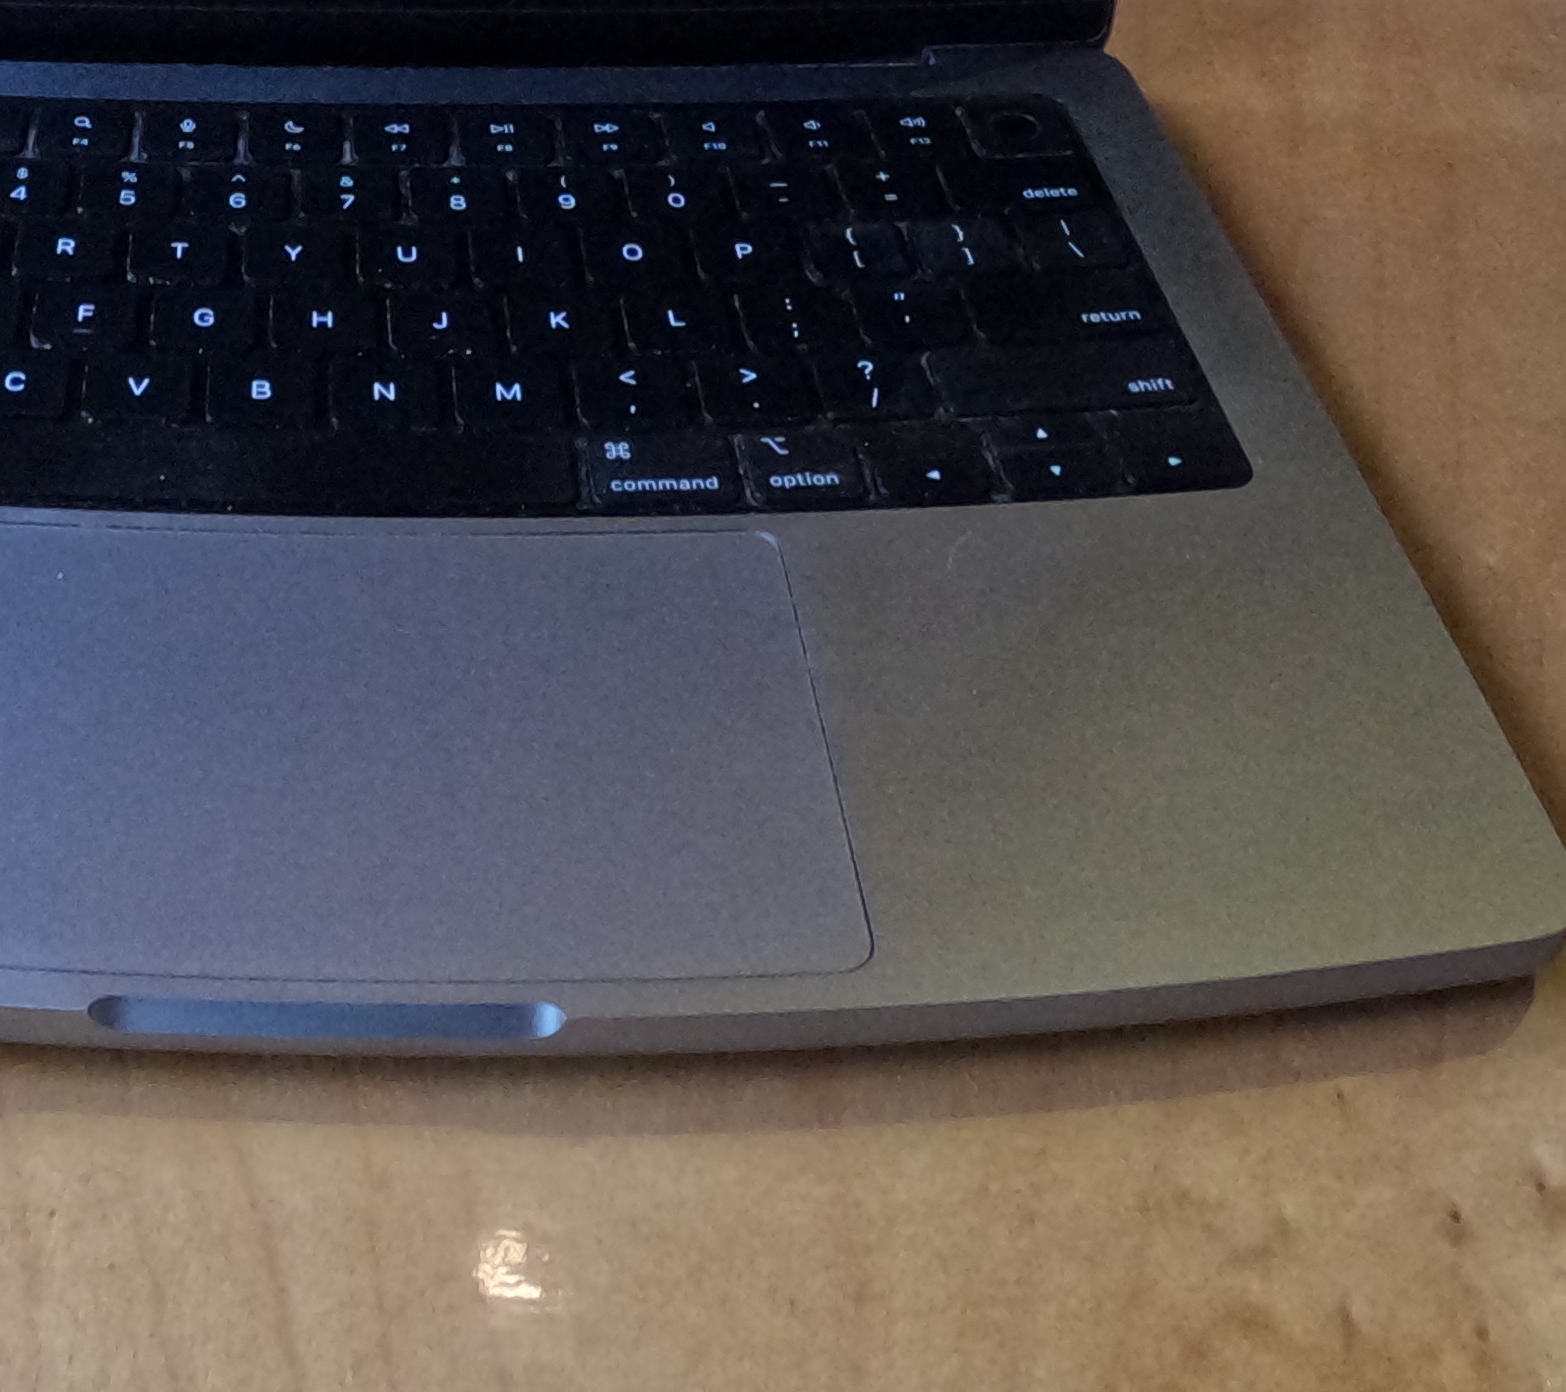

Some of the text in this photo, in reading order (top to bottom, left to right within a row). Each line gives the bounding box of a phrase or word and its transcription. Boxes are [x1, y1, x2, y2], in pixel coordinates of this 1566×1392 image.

[10, 185, 28, 201] 4
[119, 189, 136, 205] 5
[229, 192, 246, 208] 6
[340, 194, 355, 209] 7
[558, 193, 576, 209] 9
[1023, 187, 1078, 199] delete
[450, 195, 467, 210] 8
[56, 237, 76, 255] R
[171, 242, 189, 259] T
[284, 245, 303, 261] Y
[396, 246, 418, 263] U
[735, 242, 753, 259] P
[77, 303, 95, 322] F
[193, 307, 215, 327] G
[311, 310, 333, 328] H
[432, 312, 448, 329] J
[549, 311, 570, 329] K
[667, 310, 686, 327] L
[1081, 311, 1141, 323] return
[857, 360, 874, 380] ?
[4, 371, 26, 392] C
[128, 377, 150, 396] V
[251, 379, 272, 400] B
[1128, 378, 1174, 392] shift
[373, 382, 396, 401] N
[495, 382, 522, 401] M
[611, 476, 719, 492] command
[769, 472, 839, 489] option
